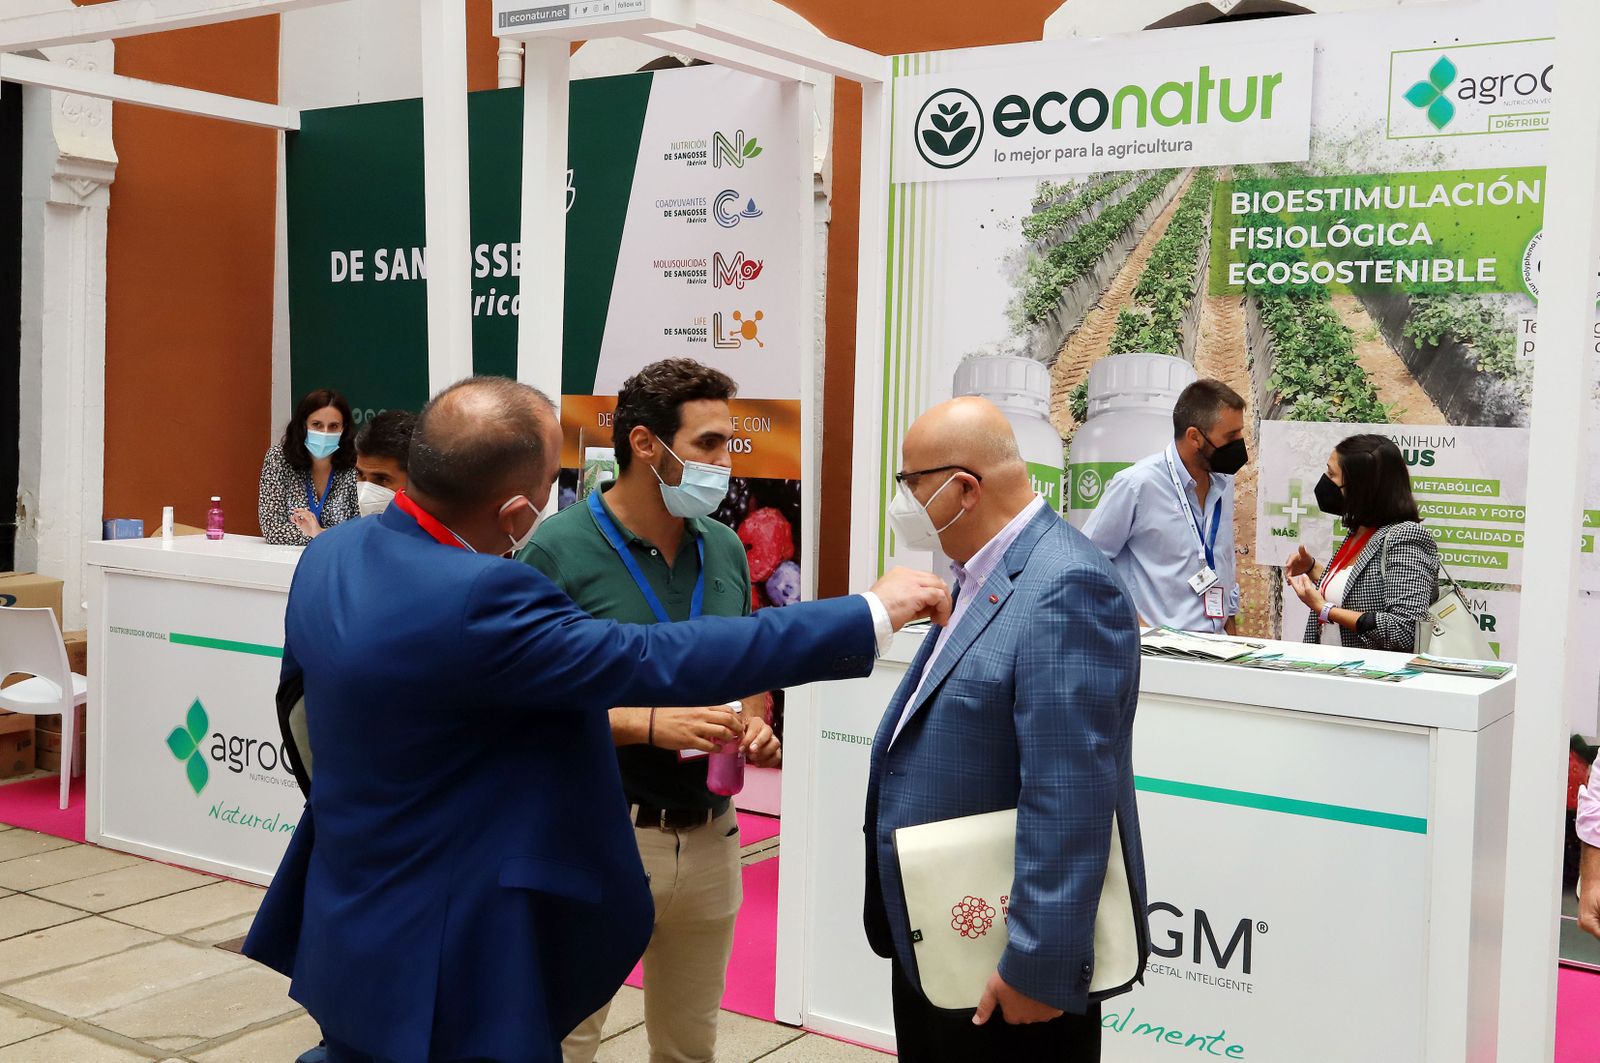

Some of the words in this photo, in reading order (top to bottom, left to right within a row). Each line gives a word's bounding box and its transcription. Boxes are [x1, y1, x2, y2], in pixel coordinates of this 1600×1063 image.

[510, 7, 567, 23] econatur.net
[993, 65, 1282, 138] econatur
[1495, 118, 1549, 129] DISTRIBU
[664, 153, 672, 161] DE
[674, 150, 707, 159] SANGOSSE
[993, 148, 1007, 163] lo
[1010, 148, 1052, 165] mejor
[1055, 147, 1088, 163] para
[1091, 142, 1105, 158] la
[1107, 139, 1193, 158] agricultura
[1231, 175, 1542, 215] BIOESTIMULACIÓN
[655, 197, 707, 208] COADYUVANTES
[674, 208, 707, 216] SANGOSSE
[1230, 219, 1434, 250] FISIOLÓGICA
[331, 250, 364, 283] DE
[653, 259, 707, 268] MOLUSQUICIDAS
[674, 269, 707, 277] SANGOSSE
[1228, 258, 1497, 285] ECOSOSTENIBLE
[694, 317, 707, 326] LIFE
[674, 327, 707, 335] SANGOSSE
[743, 416, 771, 432] CON
[1391, 434, 1457, 449] ANIHUM
[1403, 449, 1436, 467] US
[1413, 480, 1493, 494] METABÓLICA
[1491, 510, 1525, 519] FOTO
[1456, 530, 1512, 542] CALIDAD
[1436, 552, 1501, 566] ODUCTIVA.
[109, 626, 145, 638] DISTRIBUIDOR
[145, 631, 166, 640] OFICIAL
[821, 730, 872, 746] DISTRIBUID
[1145, 961, 1182, 979] EGETAL
[1185, 971, 1253, 994] INTELIGENTE
[1101, 1007, 1245, 1060] almente
